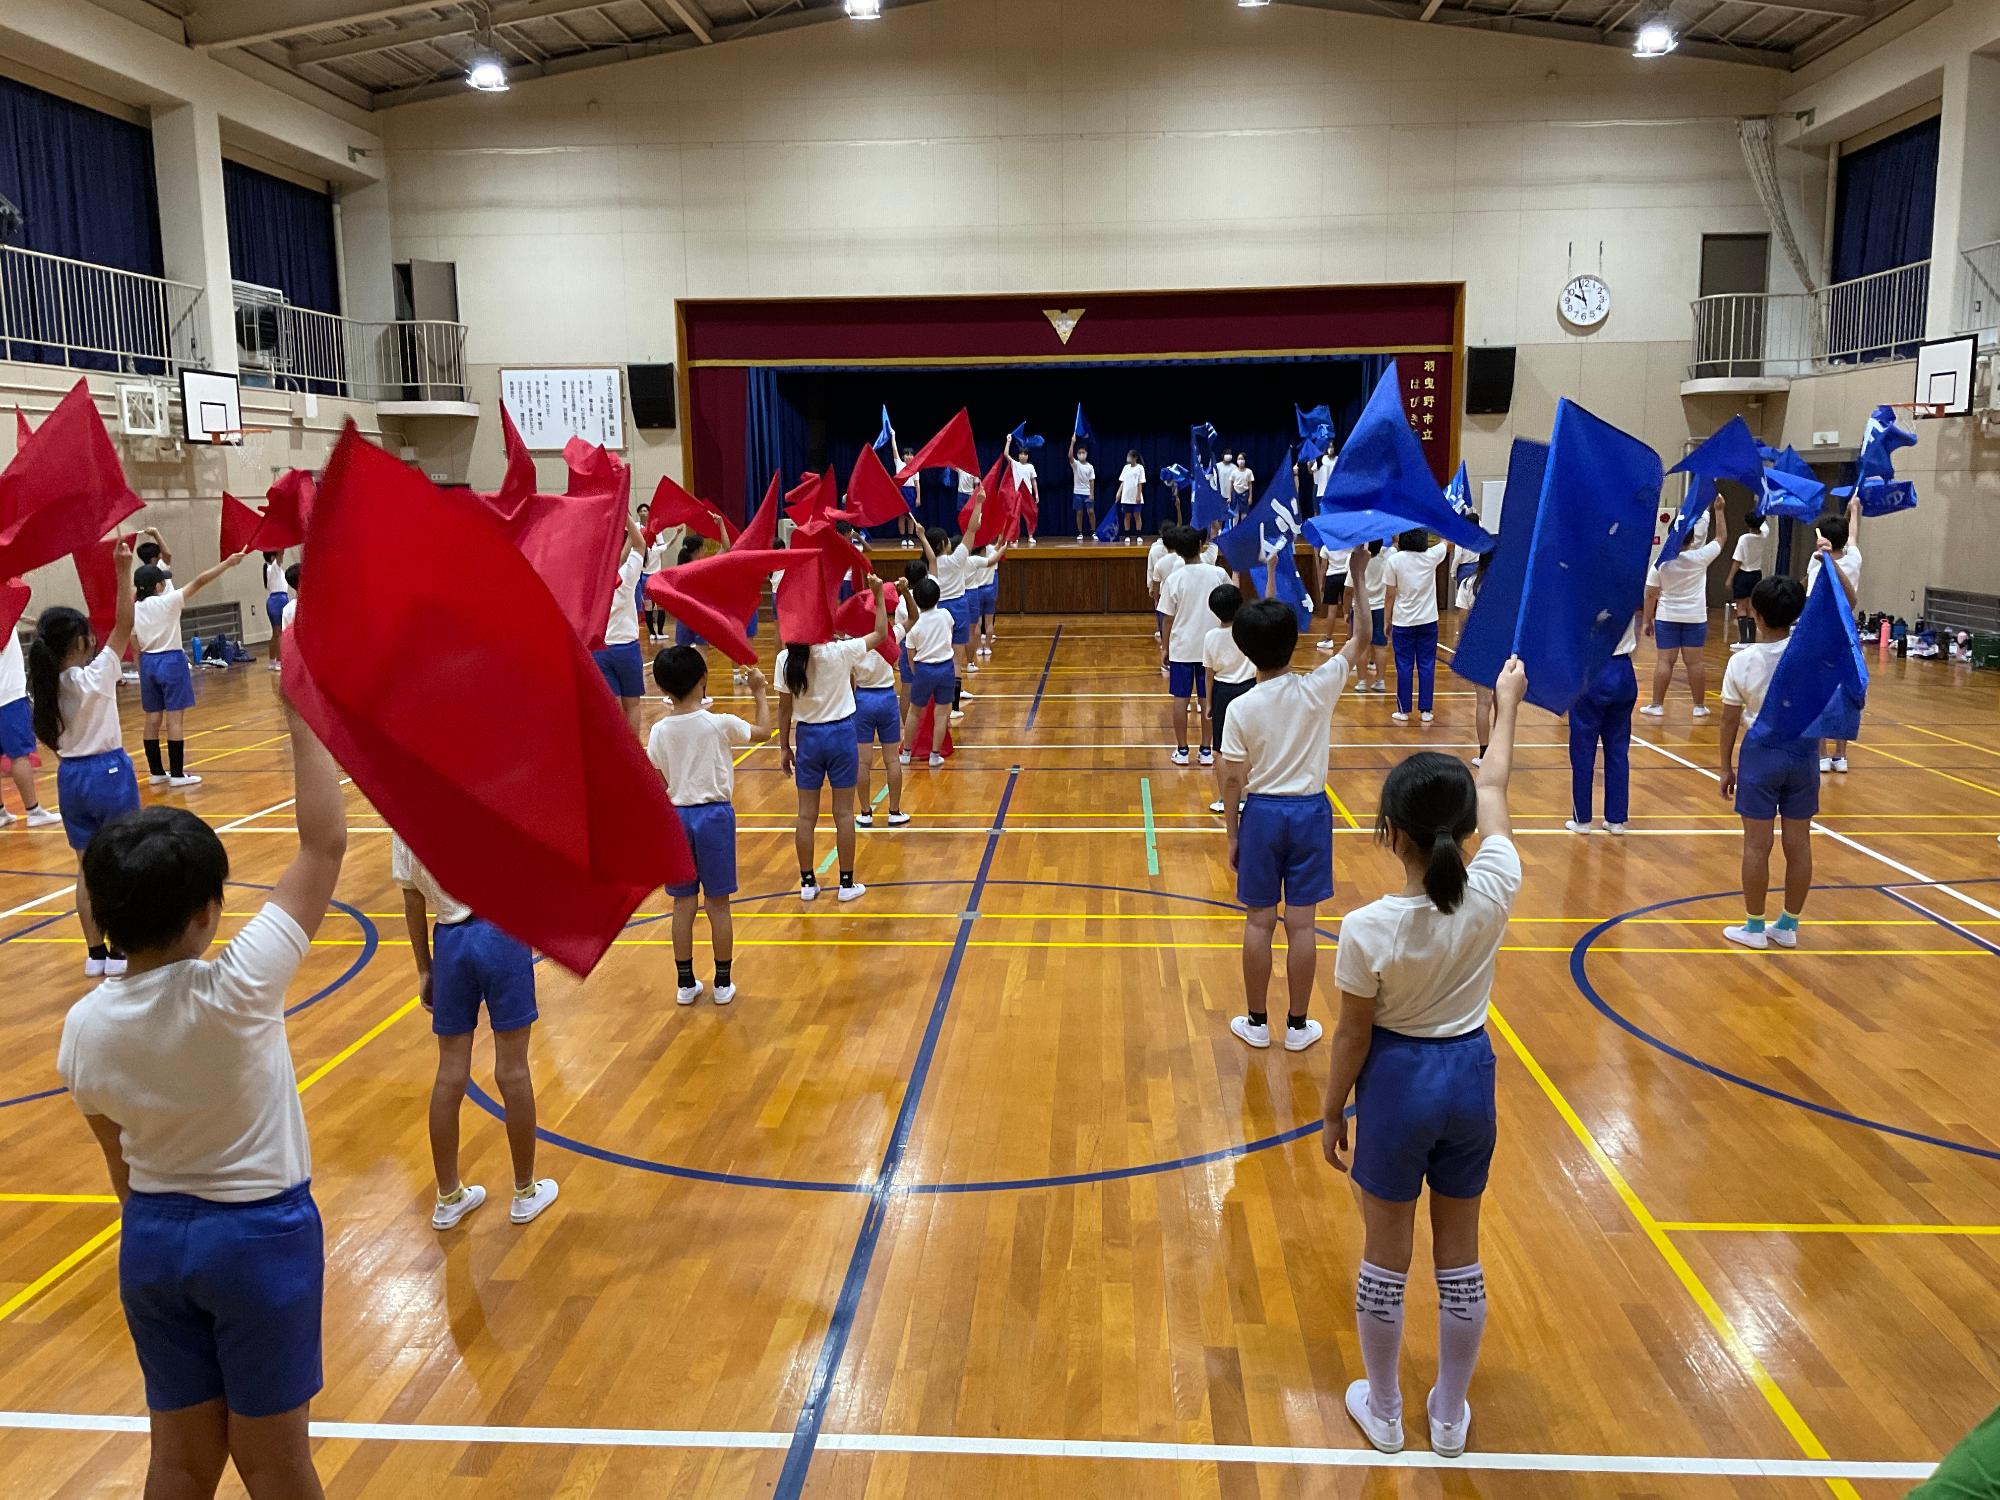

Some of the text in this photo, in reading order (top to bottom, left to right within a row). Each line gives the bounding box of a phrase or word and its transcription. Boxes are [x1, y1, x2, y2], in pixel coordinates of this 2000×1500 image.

[1581, 279, 1590, 288] 12
[1567, 288, 1575, 296] 10
[1597, 287, 1603, 295] 2
[1567, 304, 1573, 312] 8
[1581, 313, 1587, 321] 6
[1422, 361, 1435, 440] 羽曳野市立
[1410, 379, 1420, 432] はびき
